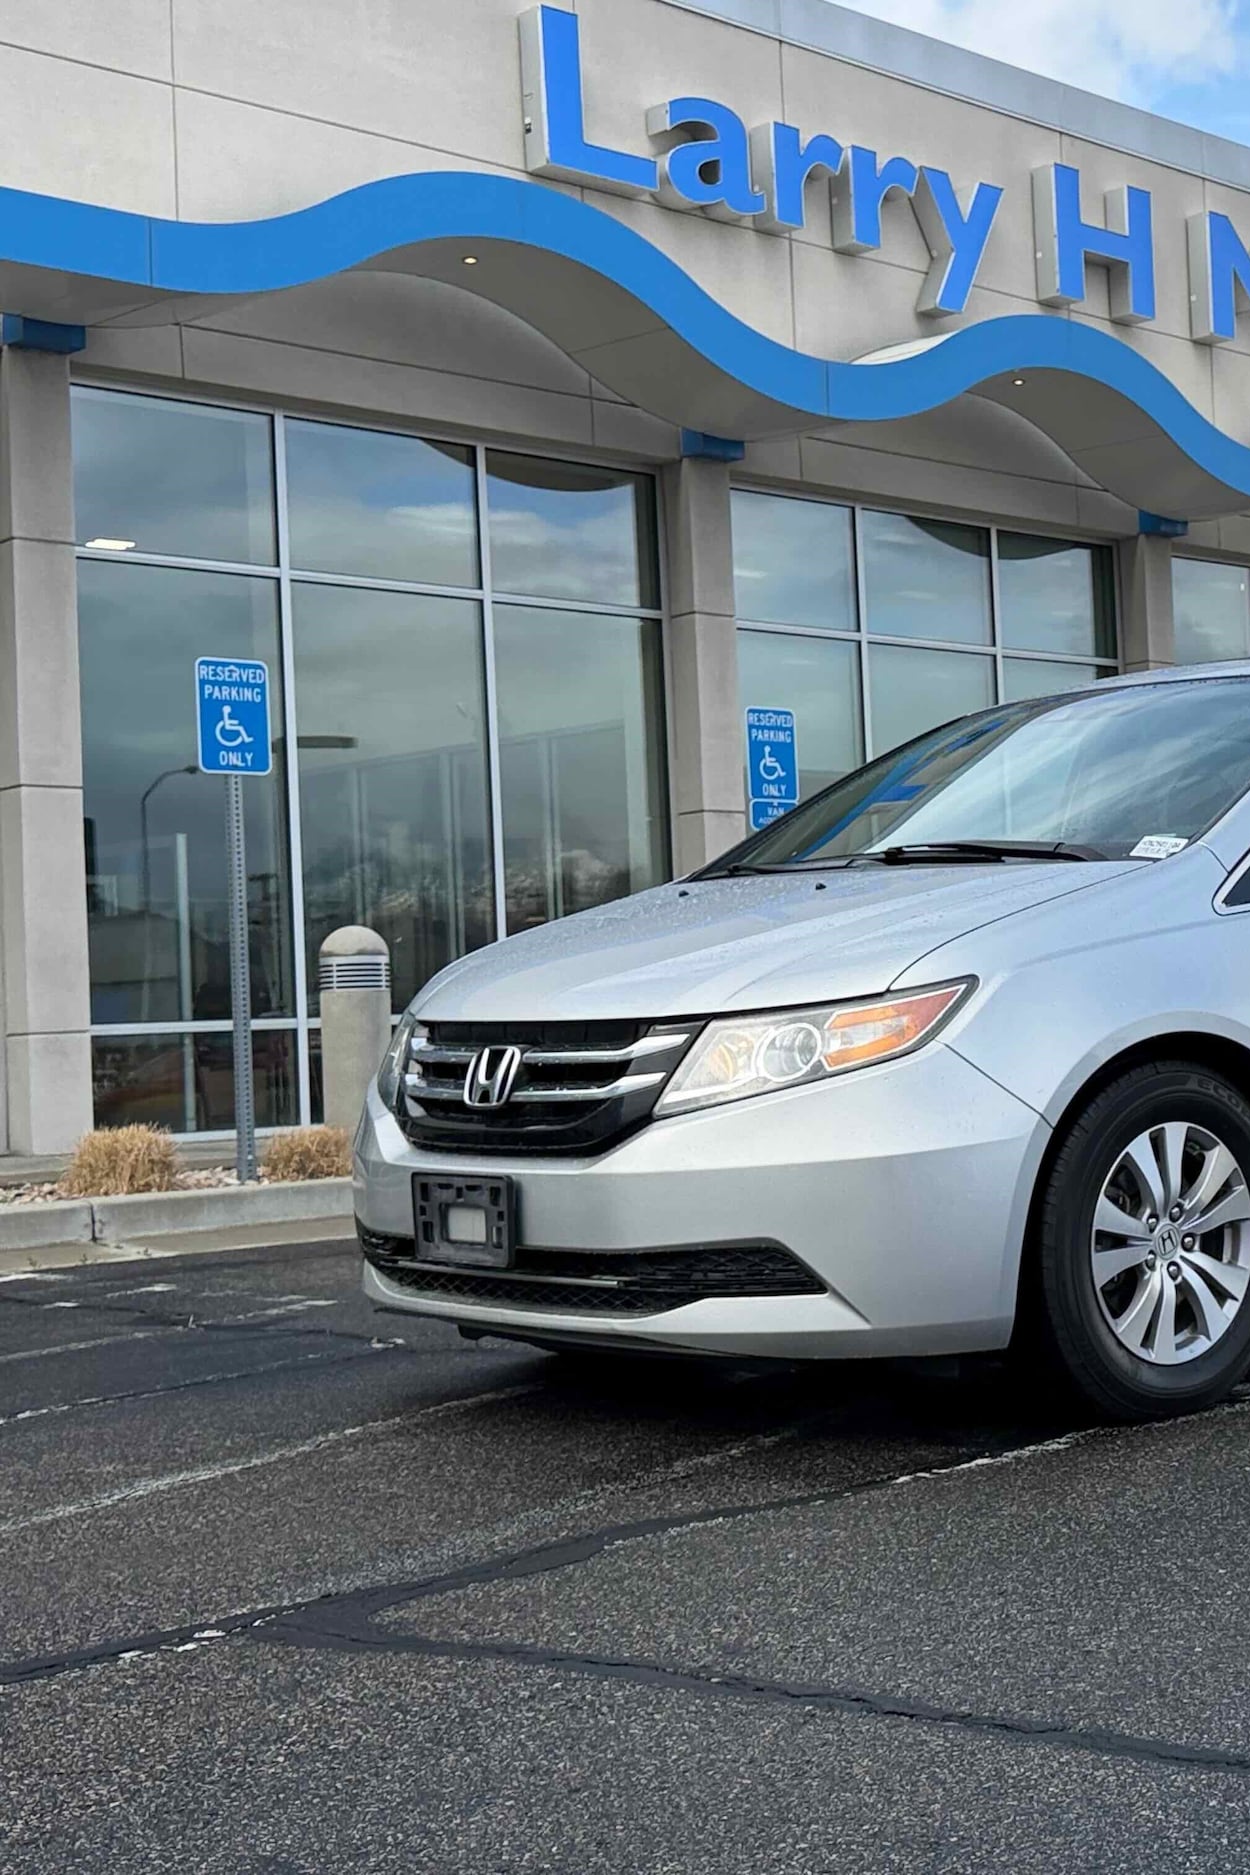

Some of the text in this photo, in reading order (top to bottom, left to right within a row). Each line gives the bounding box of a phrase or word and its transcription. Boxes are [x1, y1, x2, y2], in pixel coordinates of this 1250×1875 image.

[537, 4, 1004, 313] Larry
[1050, 162, 1156, 321] H
[199, 664, 265, 684] RESERVED
[204, 684, 262, 703] PARKING
[748, 712, 793, 728] RESERVED
[751, 729, 792, 744] PARKING
[219, 750, 254, 767] ONLY
[762, 783, 787, 797] ONLY
